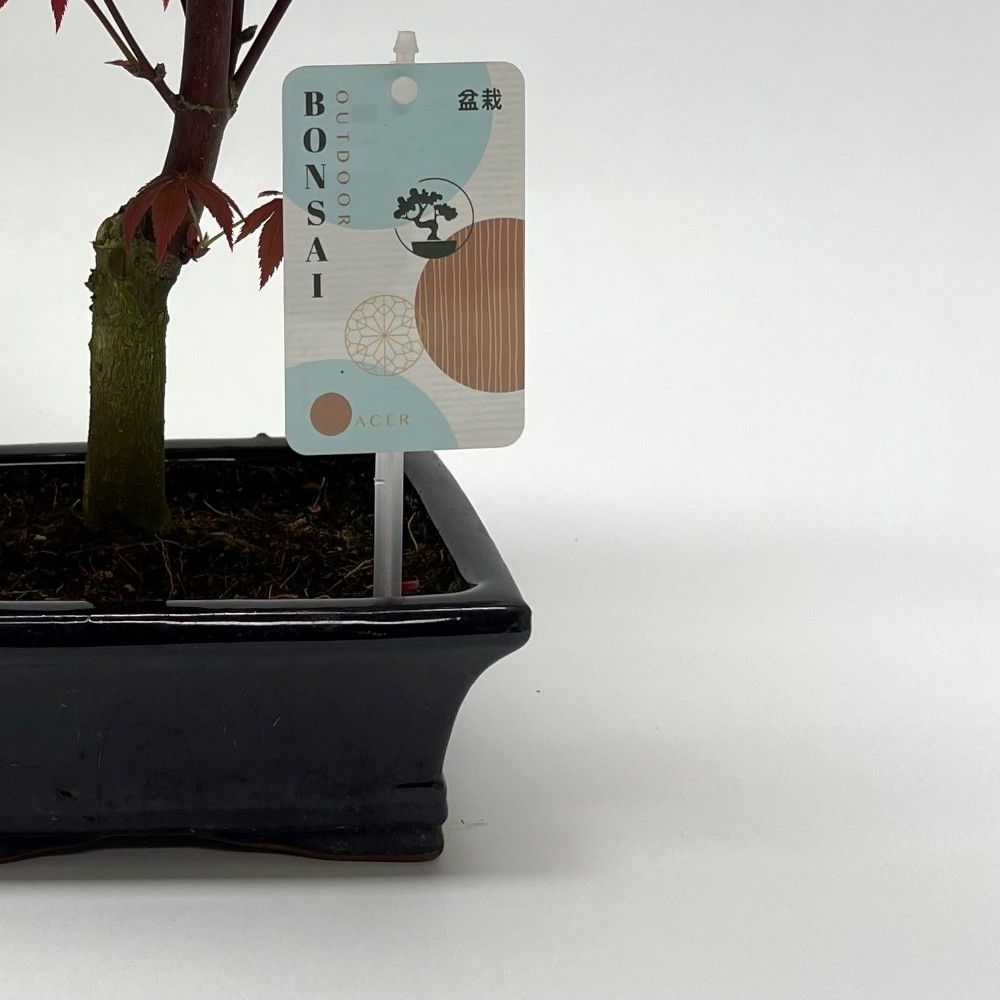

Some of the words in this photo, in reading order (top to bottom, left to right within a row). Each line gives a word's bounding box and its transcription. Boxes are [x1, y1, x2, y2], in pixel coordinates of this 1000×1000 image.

[457, 87, 503, 112] 盆栽
[303, 90, 329, 299] BONSAI
[335, 89, 351, 226] OUTDOOR
[354, 412, 411, 427] ACER
